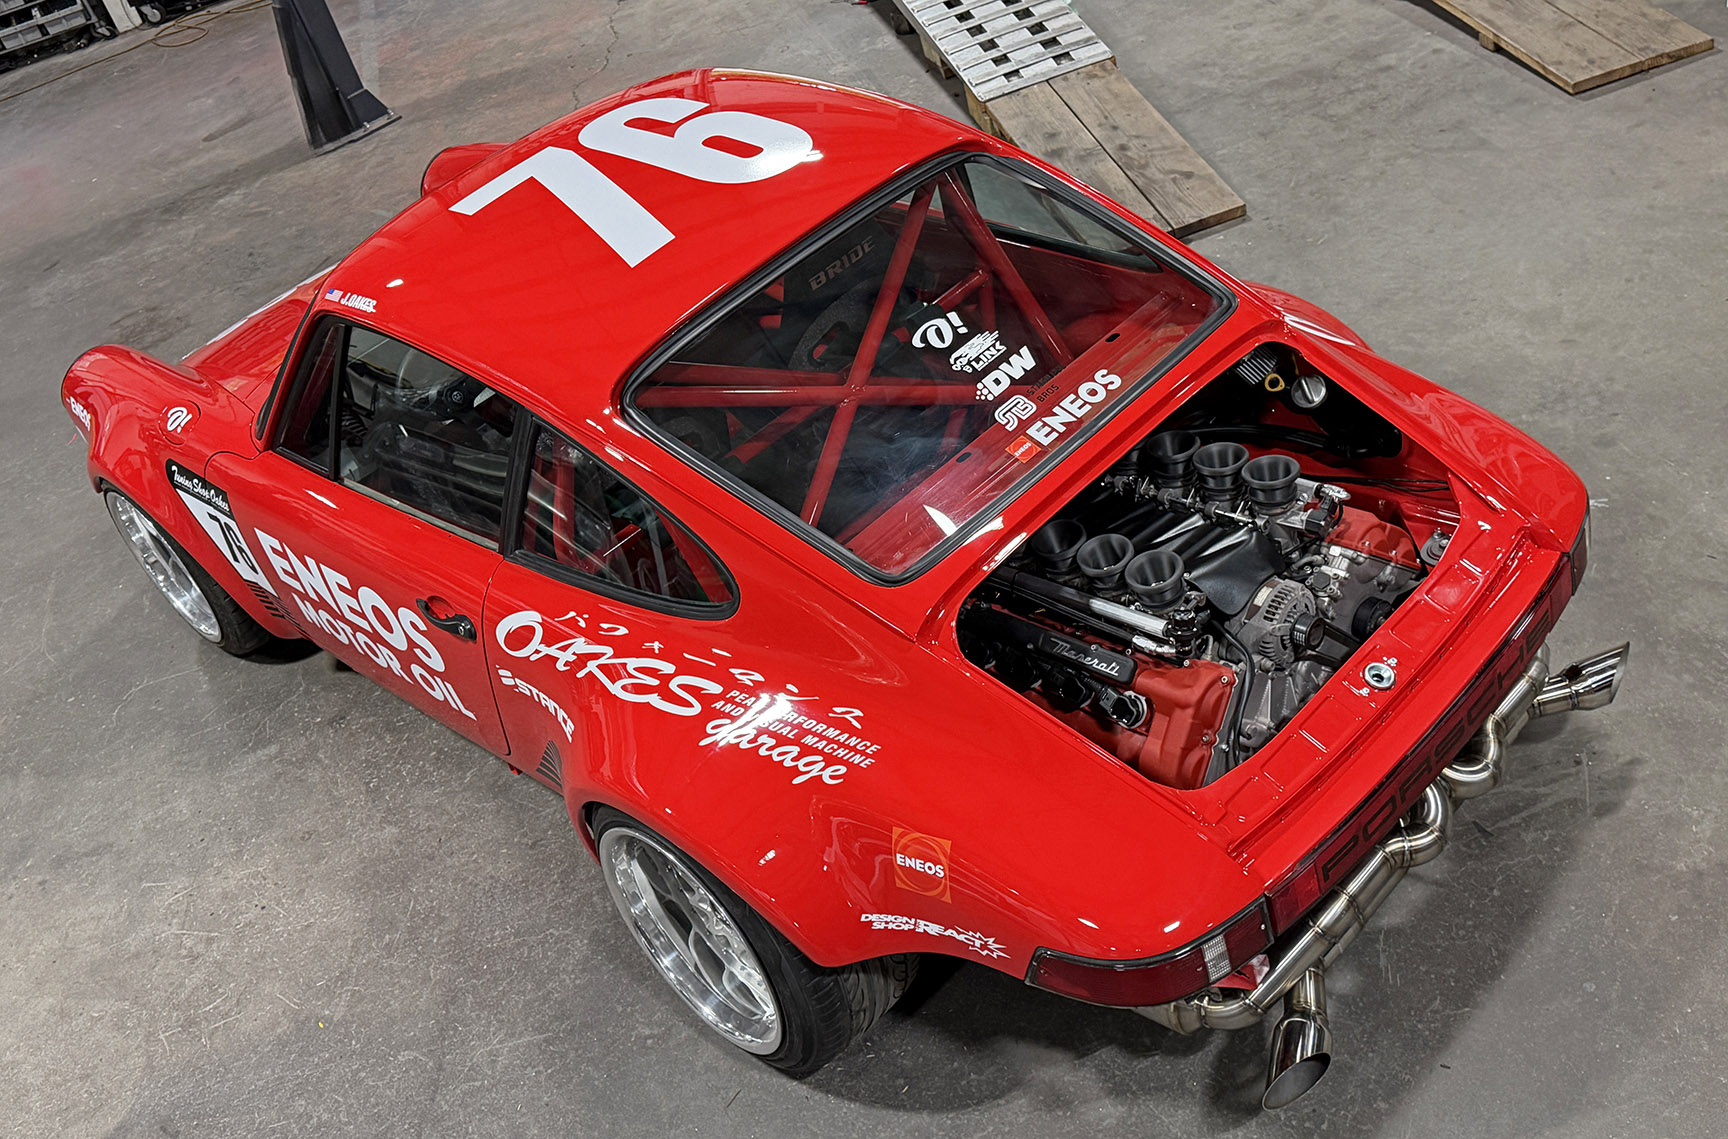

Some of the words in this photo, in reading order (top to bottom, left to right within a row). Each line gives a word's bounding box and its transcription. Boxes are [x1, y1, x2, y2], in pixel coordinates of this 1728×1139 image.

[448, 97, 813, 268] 76
[808, 235, 875, 291] BRIDE
[340, 292, 377, 313] J.OAKES
[981, 345, 1036, 397] DW
[1025, 368, 1122, 446] ENEOS
[1014, 441, 1032, 457] ENEOS
[206, 511, 259, 575] 76
[254, 527, 445, 672] ENEOS
[292, 594, 412, 685] MOTOR
[410, 664, 477, 721] OIL
[496, 611, 724, 716] OAKES
[1050, 638, 1119, 676] Maserati
[515, 677, 575, 743] STANCE
[711, 700, 745, 717] AND
[800, 734, 875, 769] MACHINE
[700, 719, 848, 785] garage
[1323, 608, 1549, 883] PORSCHE
[896, 853, 945, 878] ENEOS
[860, 913, 915, 924] DESIGN
[871, 922, 915, 931] SHOP
